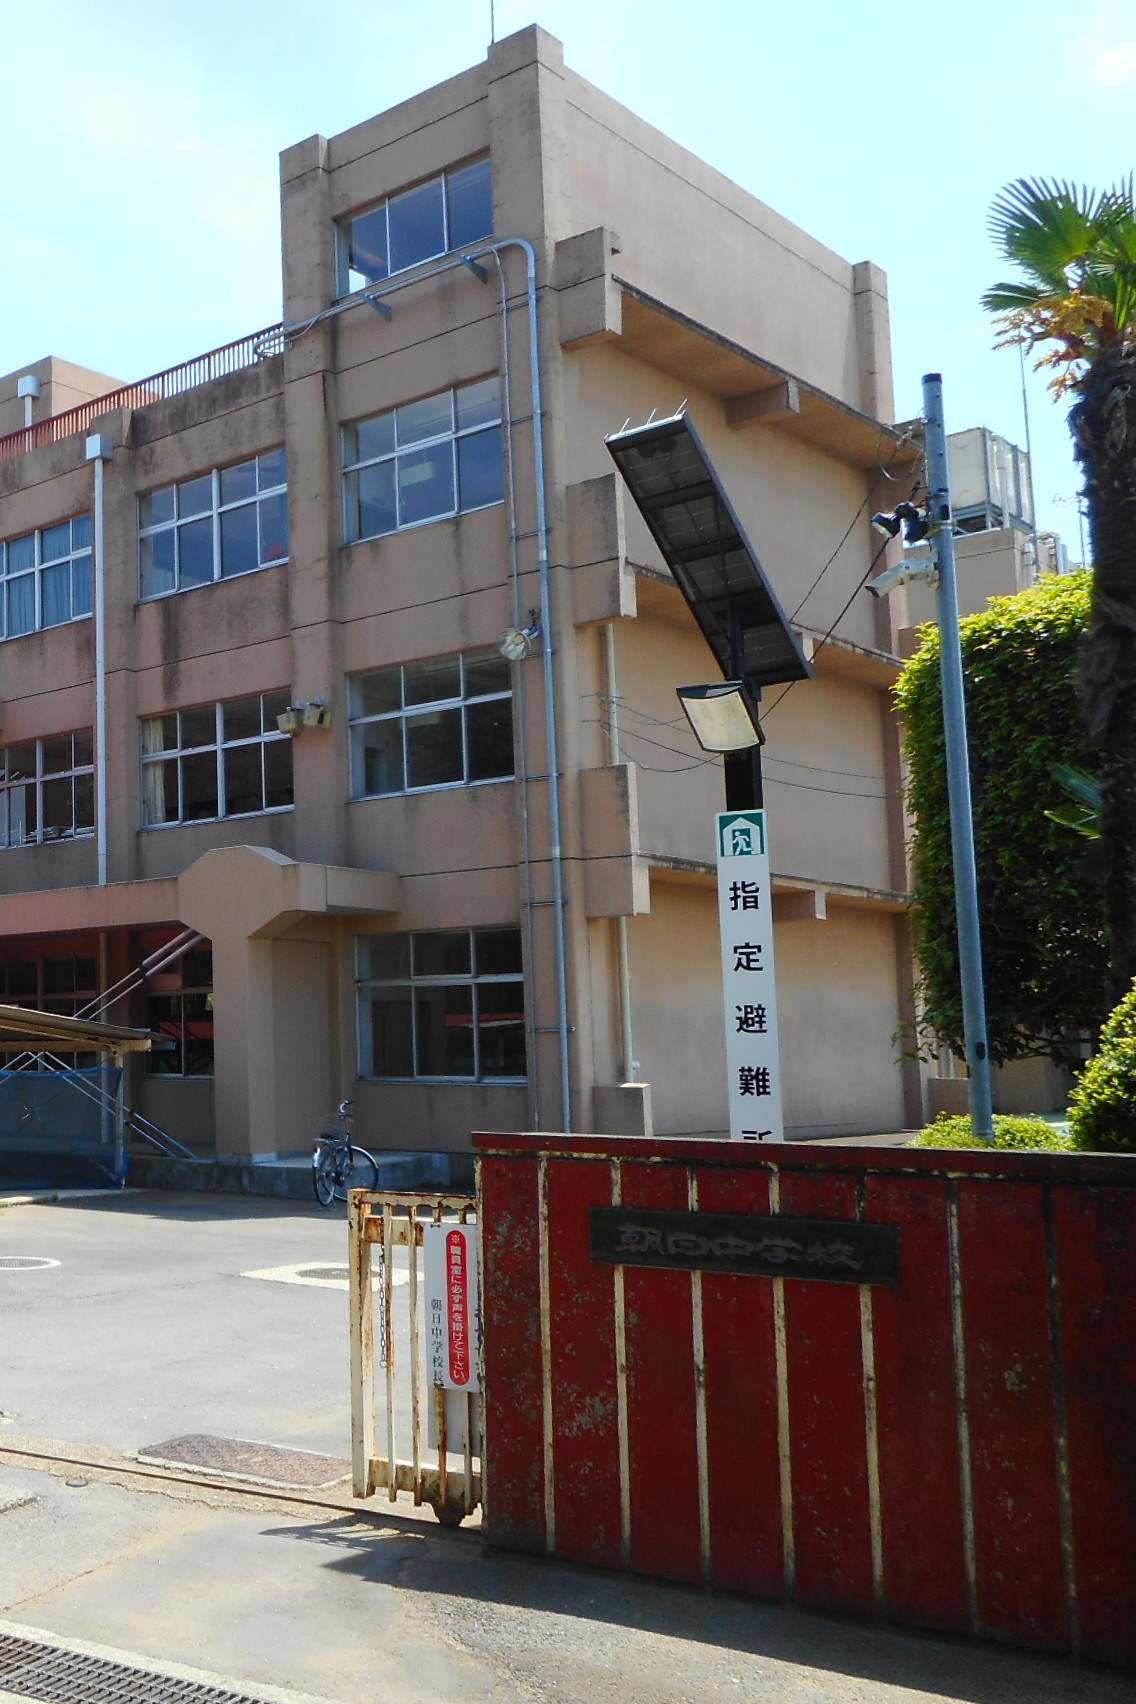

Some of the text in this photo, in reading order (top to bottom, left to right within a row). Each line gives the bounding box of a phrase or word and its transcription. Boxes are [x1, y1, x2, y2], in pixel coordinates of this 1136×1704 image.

[616, 1223, 863, 1270] 朝日中学校
[430, 1298, 444, 1382] 朝日中学校長
